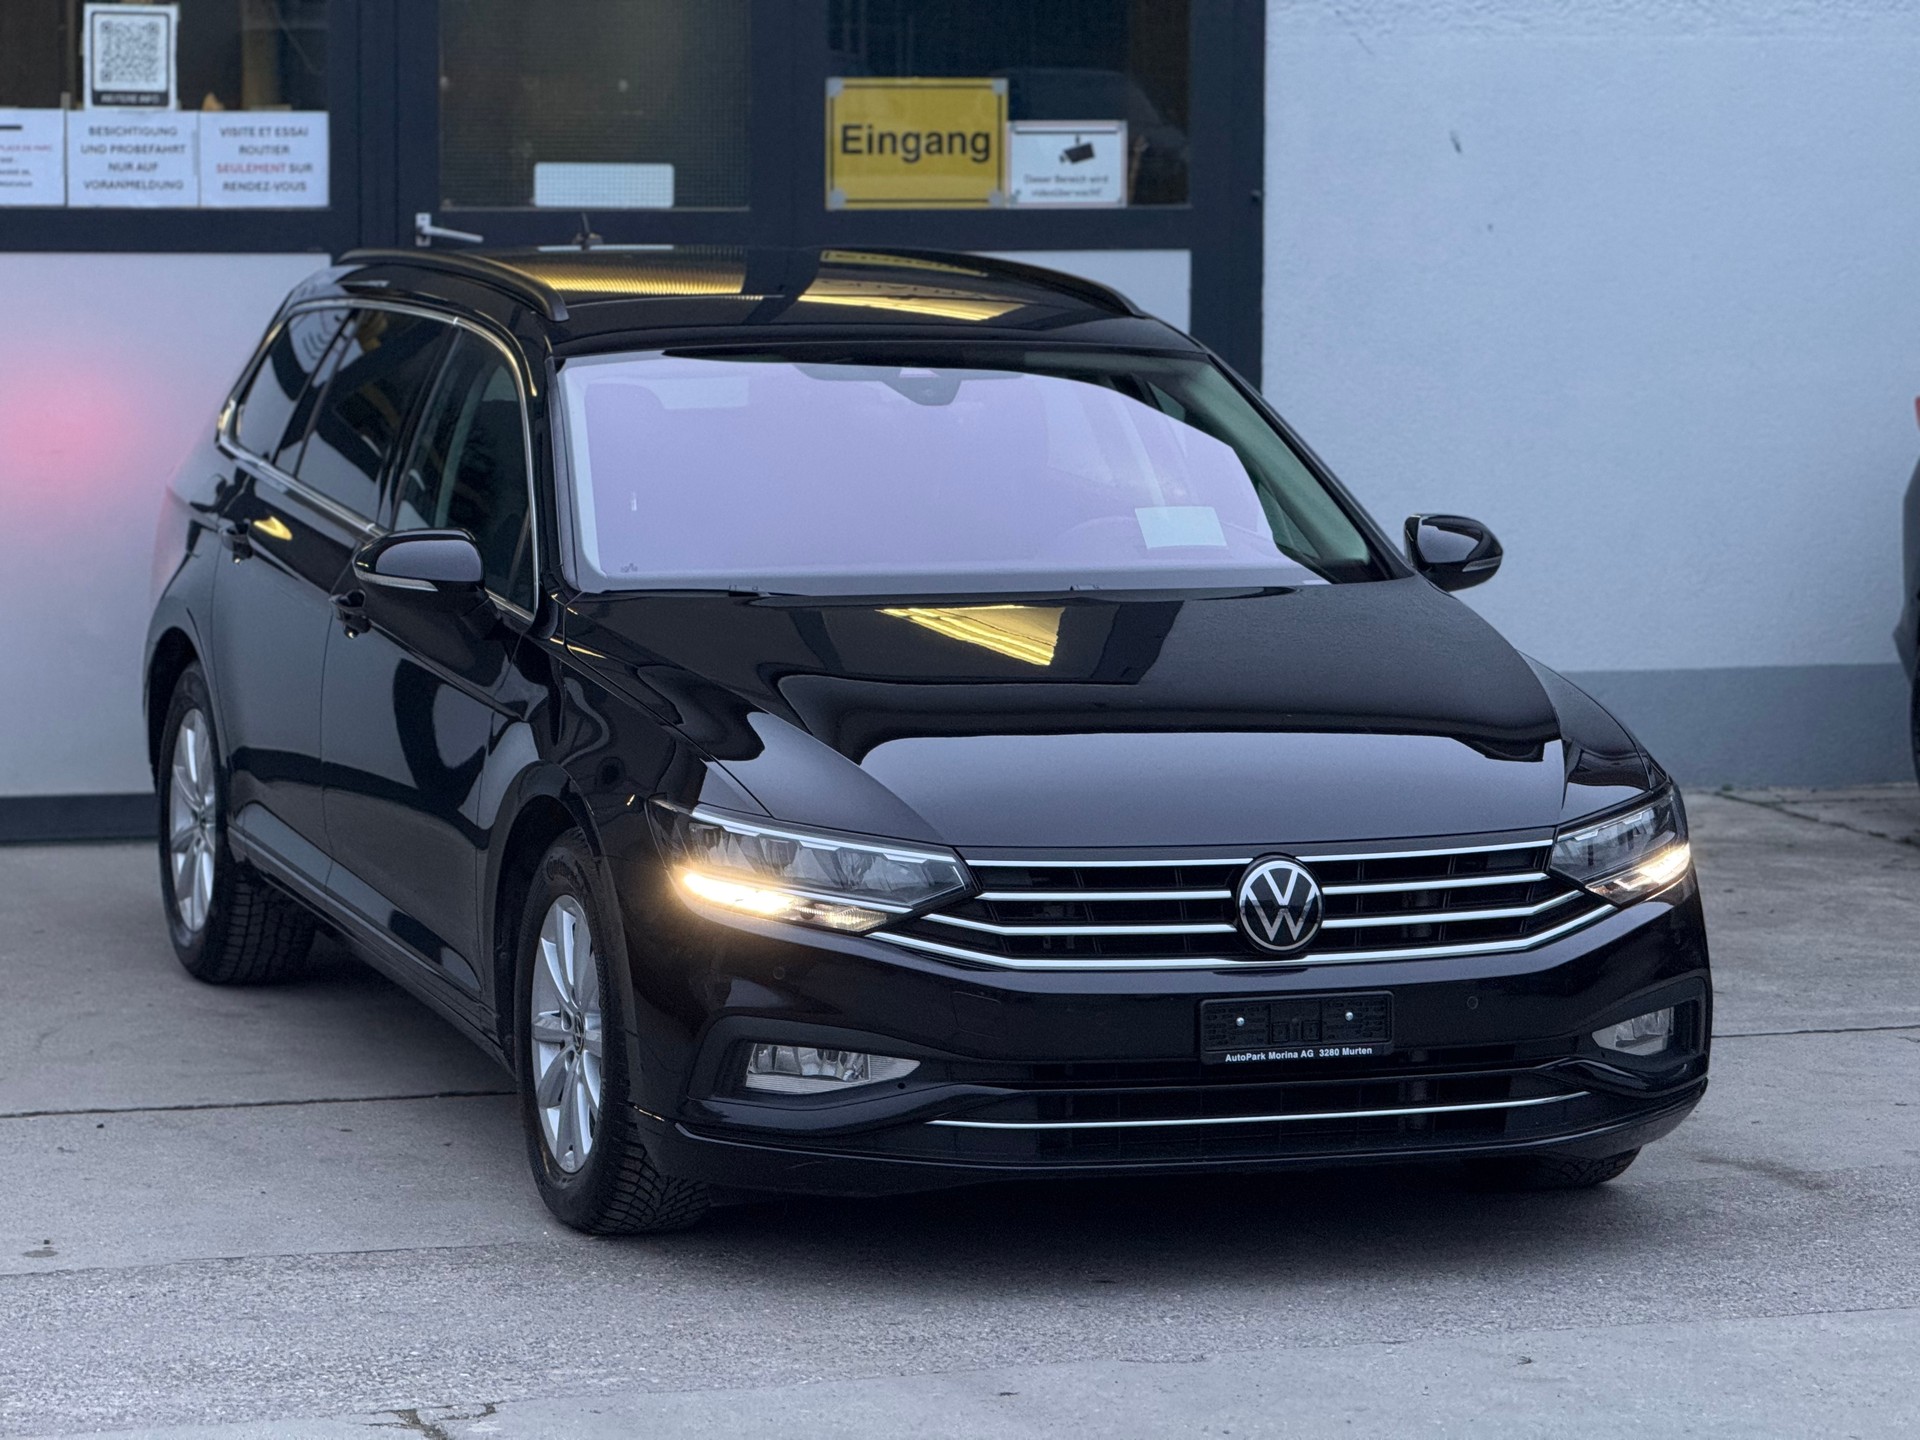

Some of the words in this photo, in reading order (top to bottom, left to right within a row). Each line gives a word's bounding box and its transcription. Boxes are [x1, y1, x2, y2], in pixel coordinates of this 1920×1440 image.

[89, 126, 178, 137] BESICHTIGUNG
[220, 127, 255, 137] VISITE
[259, 127, 272, 137] ET
[274, 127, 309, 137] ESSAI
[841, 124, 990, 163] Eingang
[81, 144, 107, 154] UND
[110, 144, 186, 154] PROBEFAHRT
[108, 162, 133, 172] NUR
[136, 162, 158, 172] AUF
[216, 163, 286, 173] SEULEMENT
[289, 163, 313, 173] SUR
[83, 180, 184, 190] VORANMELDUNG
[223, 181, 307, 191] RENDEZ-VOUS
[1225, 1053, 1266, 1063] AutoPark
[1268, 1051, 1298, 1060] Morina
[1300, 1050, 1314, 1058] AG
[1319, 1048, 1340, 1057] 3280
[1342, 1047, 1373, 1056] Murten
